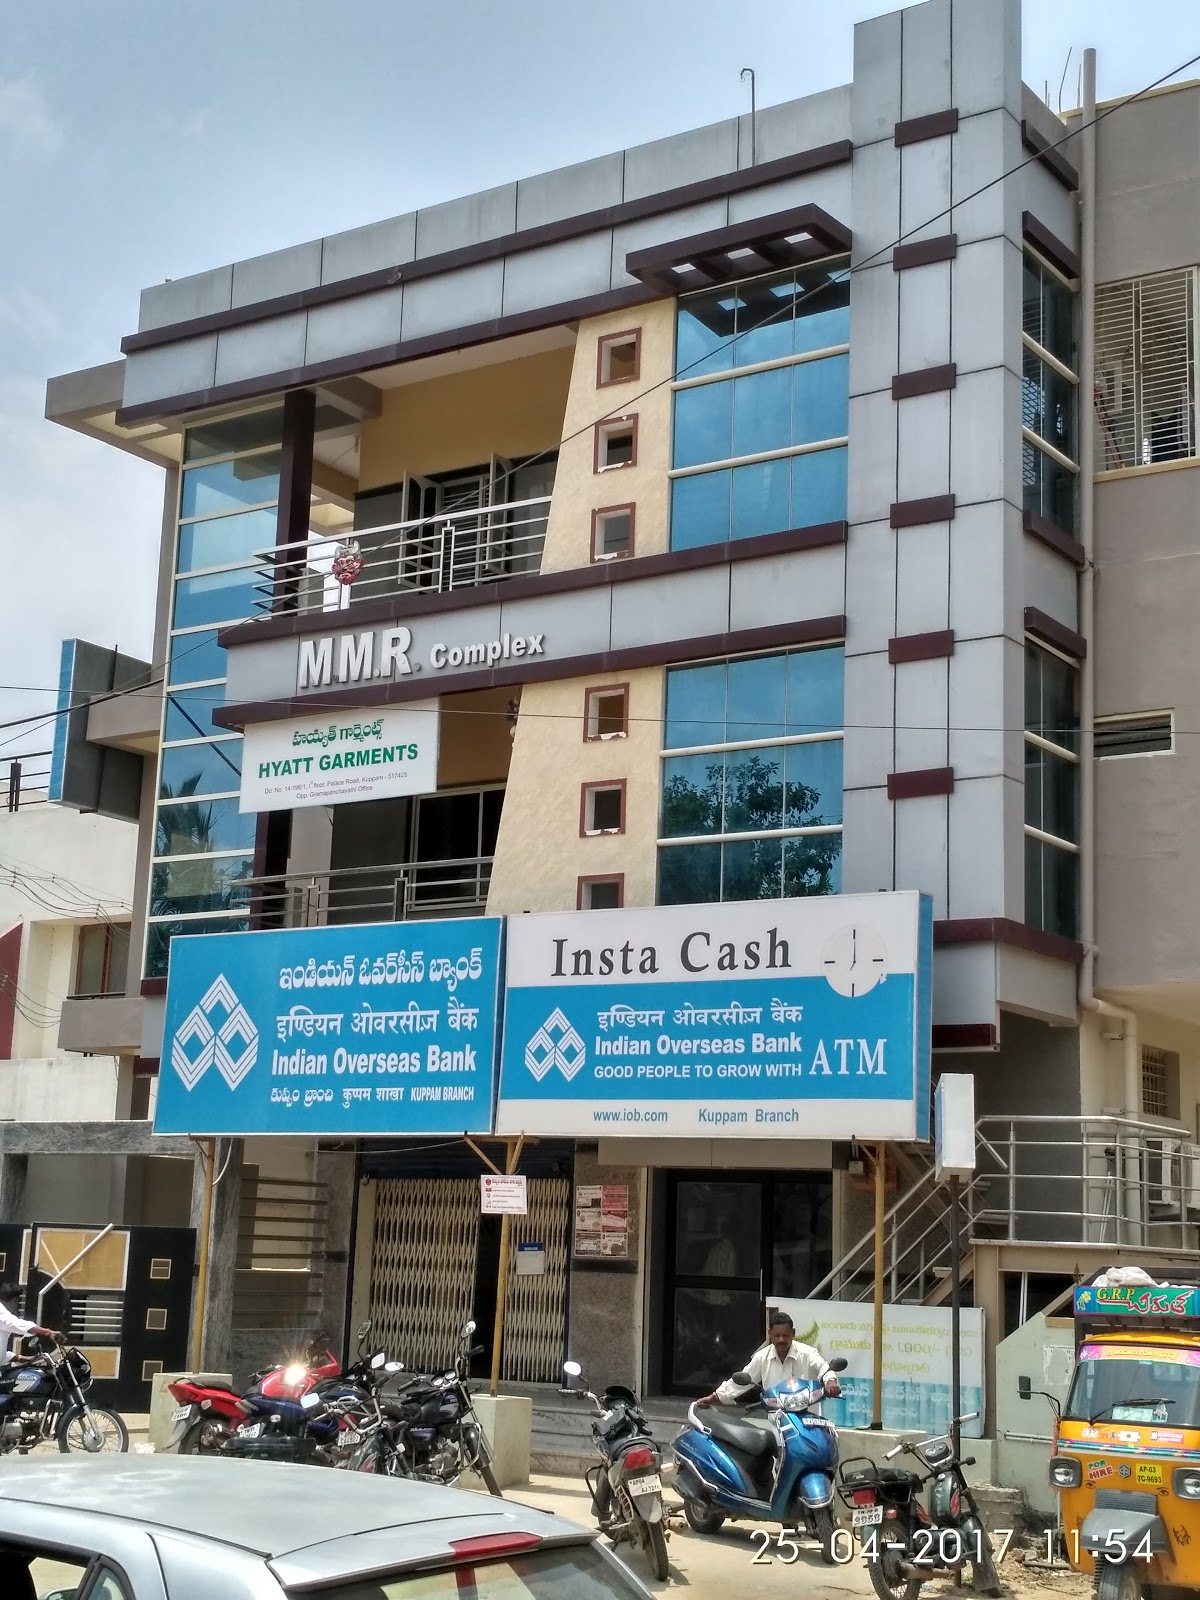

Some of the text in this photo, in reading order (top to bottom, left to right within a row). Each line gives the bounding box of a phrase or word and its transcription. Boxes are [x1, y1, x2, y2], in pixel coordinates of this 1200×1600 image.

[430, 633, 545, 668] Complex
[258, 743, 419, 780] HYATT GARMENTS
[361, 774, 384, 783] Kuppam
[357, 785, 373, 793] Office
[550, 927, 793, 977] Insta Cash
[279, 955, 356, 990] ఇండియన్
[429, 947, 483, 992] బ్యాంక్
[276, 1005, 344, 1043] इण्डियन
[447, 996, 480, 1032] बैंक
[597, 1004, 665, 1032] इण्डियन
[771, 997, 803, 1024] बैंक
[595, 1032, 802, 1055] Indian Overseas Bank
[271, 1044, 477, 1075] Indian Overseas Bank
[808, 1038, 887, 1075] ATM
[594, 1063, 802, 1078] GOOD PEOPLE TO GROW WITH
[376, 1087, 404, 1101] शाखा
[410, 1086, 475, 1101] KUPPAM BRANCH
[593, 1108, 668, 1122] www.iob.com
[698, 1108, 799, 1125] Kuppam Branch
[1096, 1287, 1135, 1301] G.R.P
[1088, 1459, 1107, 1470] FOR
[1139, 1466, 1157, 1474] AP-03
[1088, 1466, 1113, 1480] HIRE
